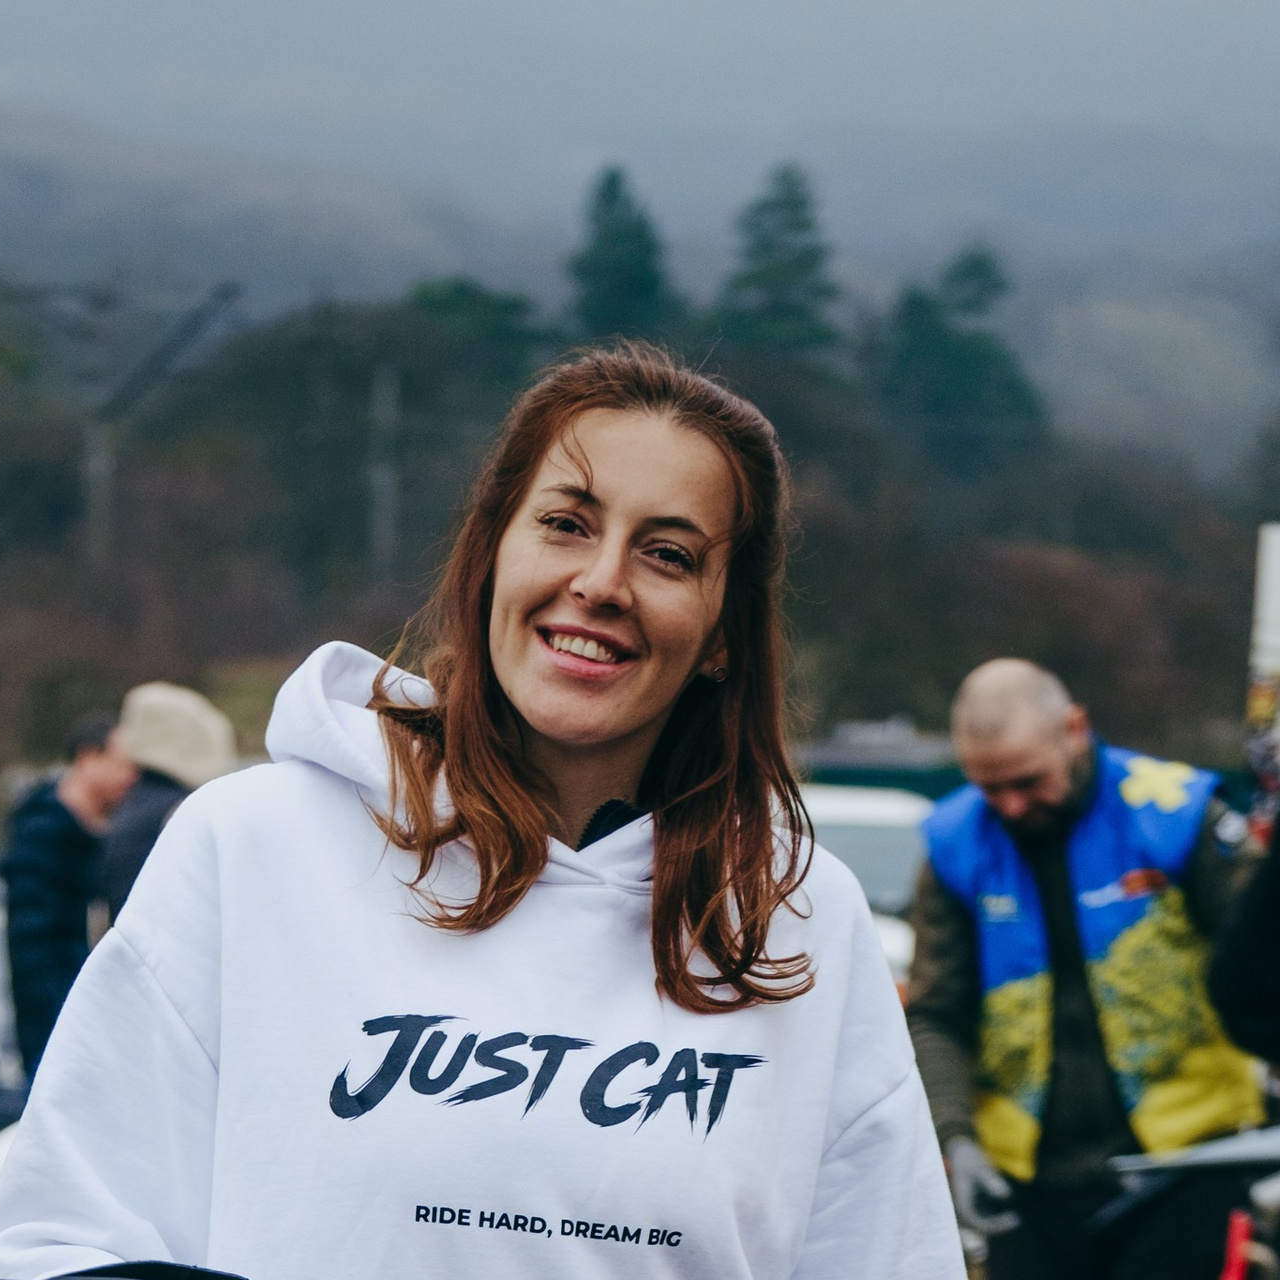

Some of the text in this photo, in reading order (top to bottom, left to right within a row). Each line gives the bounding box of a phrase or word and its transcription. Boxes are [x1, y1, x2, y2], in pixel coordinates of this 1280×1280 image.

[330, 1014, 769, 1143] JUST CAT
[415, 1205, 683, 1248] RIDE HARD, DREAM BIG
